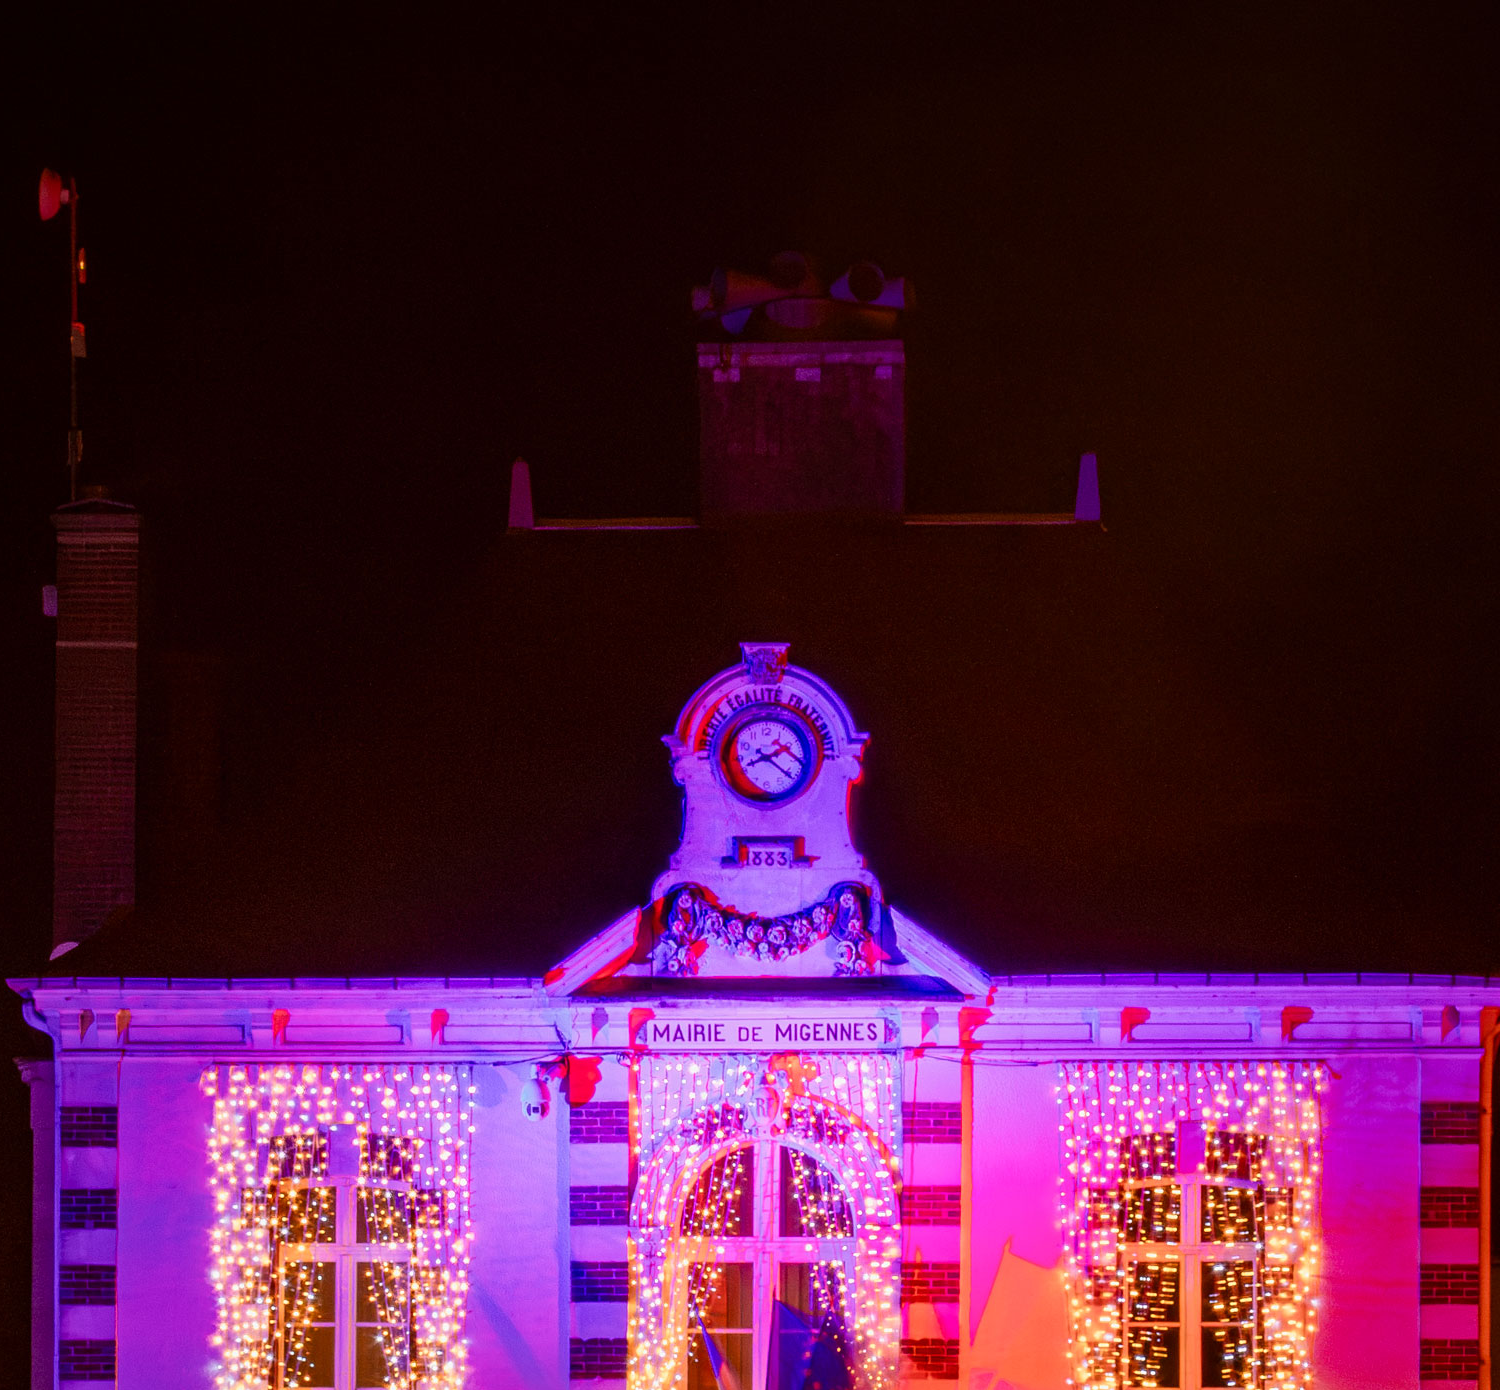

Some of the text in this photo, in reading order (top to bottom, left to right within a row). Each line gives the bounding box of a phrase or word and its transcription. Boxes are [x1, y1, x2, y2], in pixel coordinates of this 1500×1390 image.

[726, 685, 783, 713] ÉGALITÉ
[787, 693, 840, 761] FRATERNITÉ
[761, 727, 772, 736] 12
[746, 851, 788, 866] 1883
[653, 1023, 878, 1042] MAIRIE DE MIGENNES
